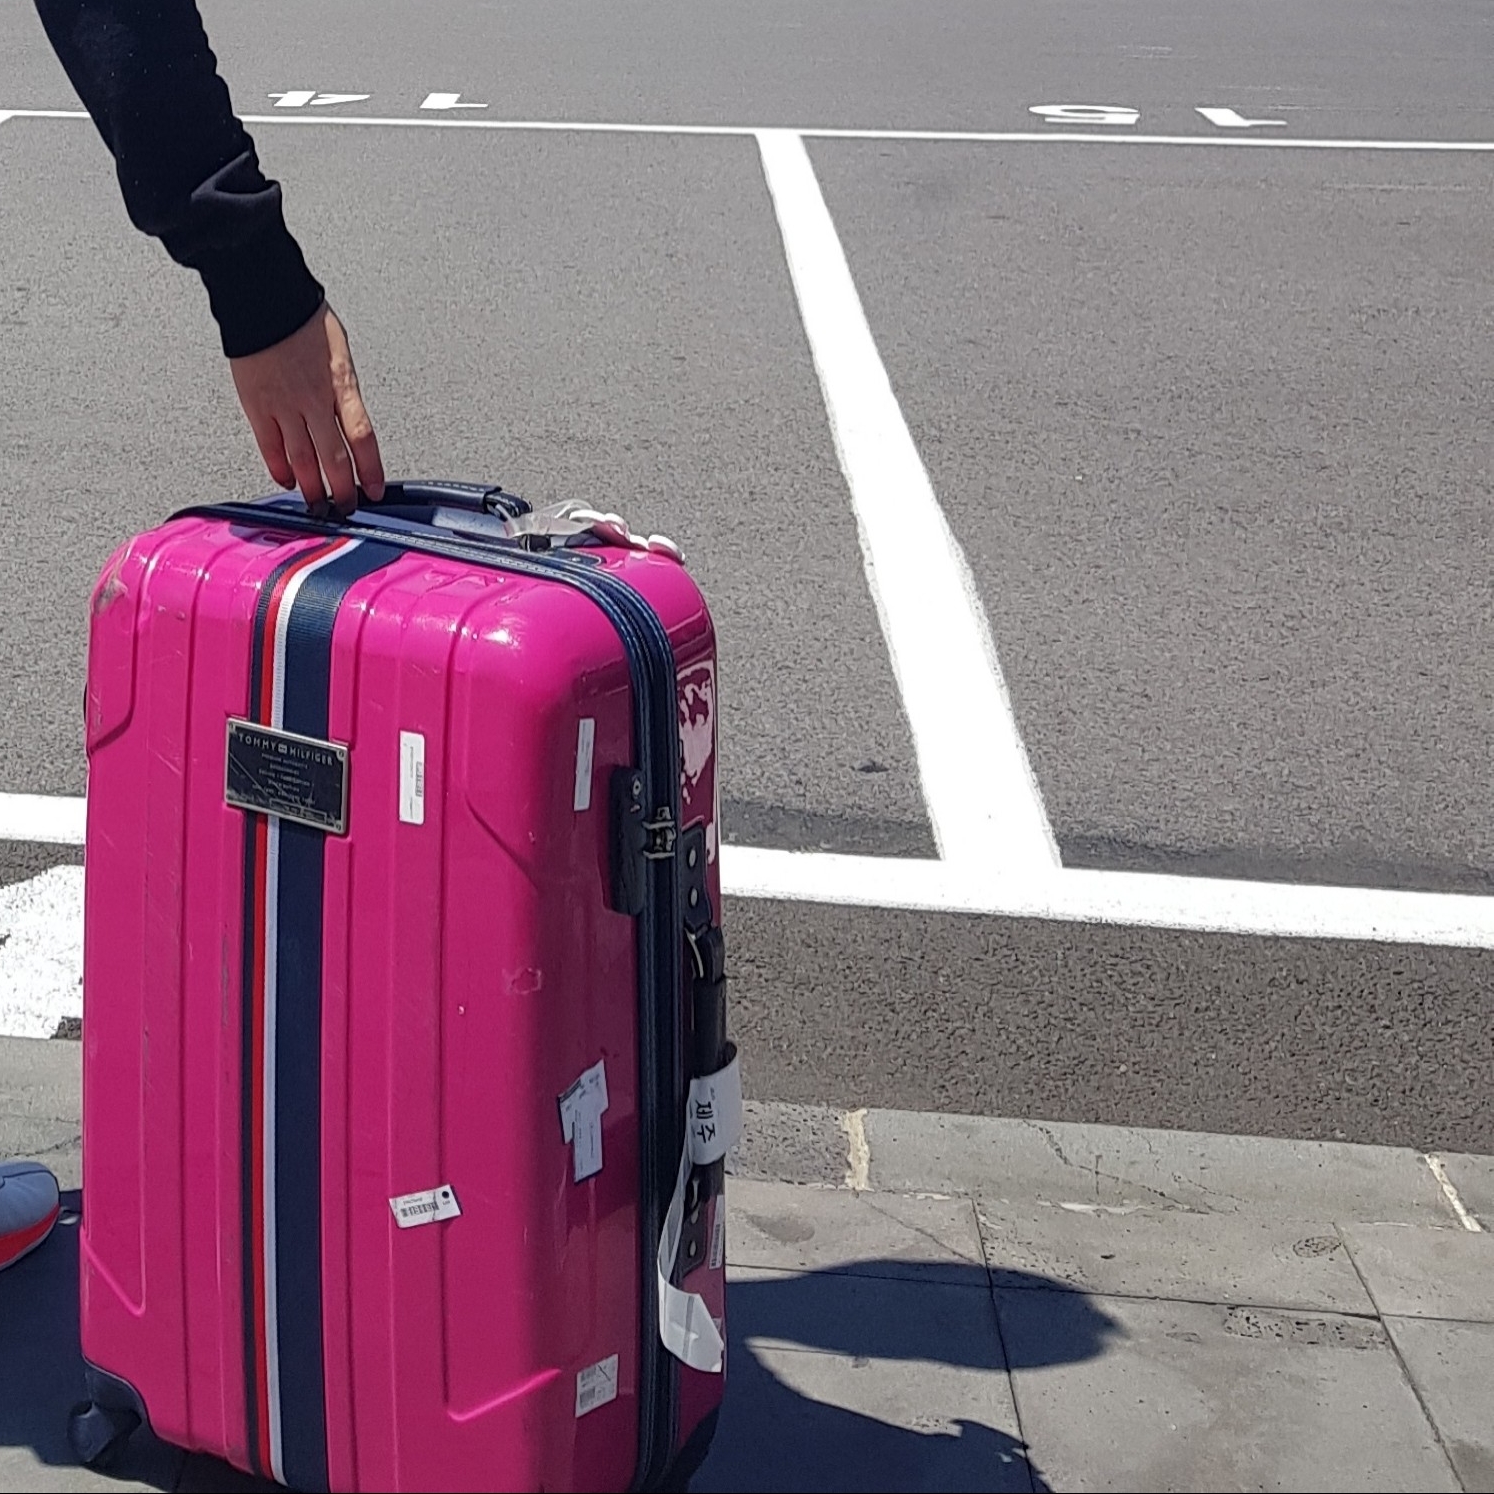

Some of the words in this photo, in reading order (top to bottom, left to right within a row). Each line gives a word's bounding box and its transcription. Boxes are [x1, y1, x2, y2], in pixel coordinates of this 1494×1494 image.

[237, 733, 276, 752] TOMMY
[289, 746, 334, 766] HILFIGER
[694, 1099, 716, 1144] 제주
